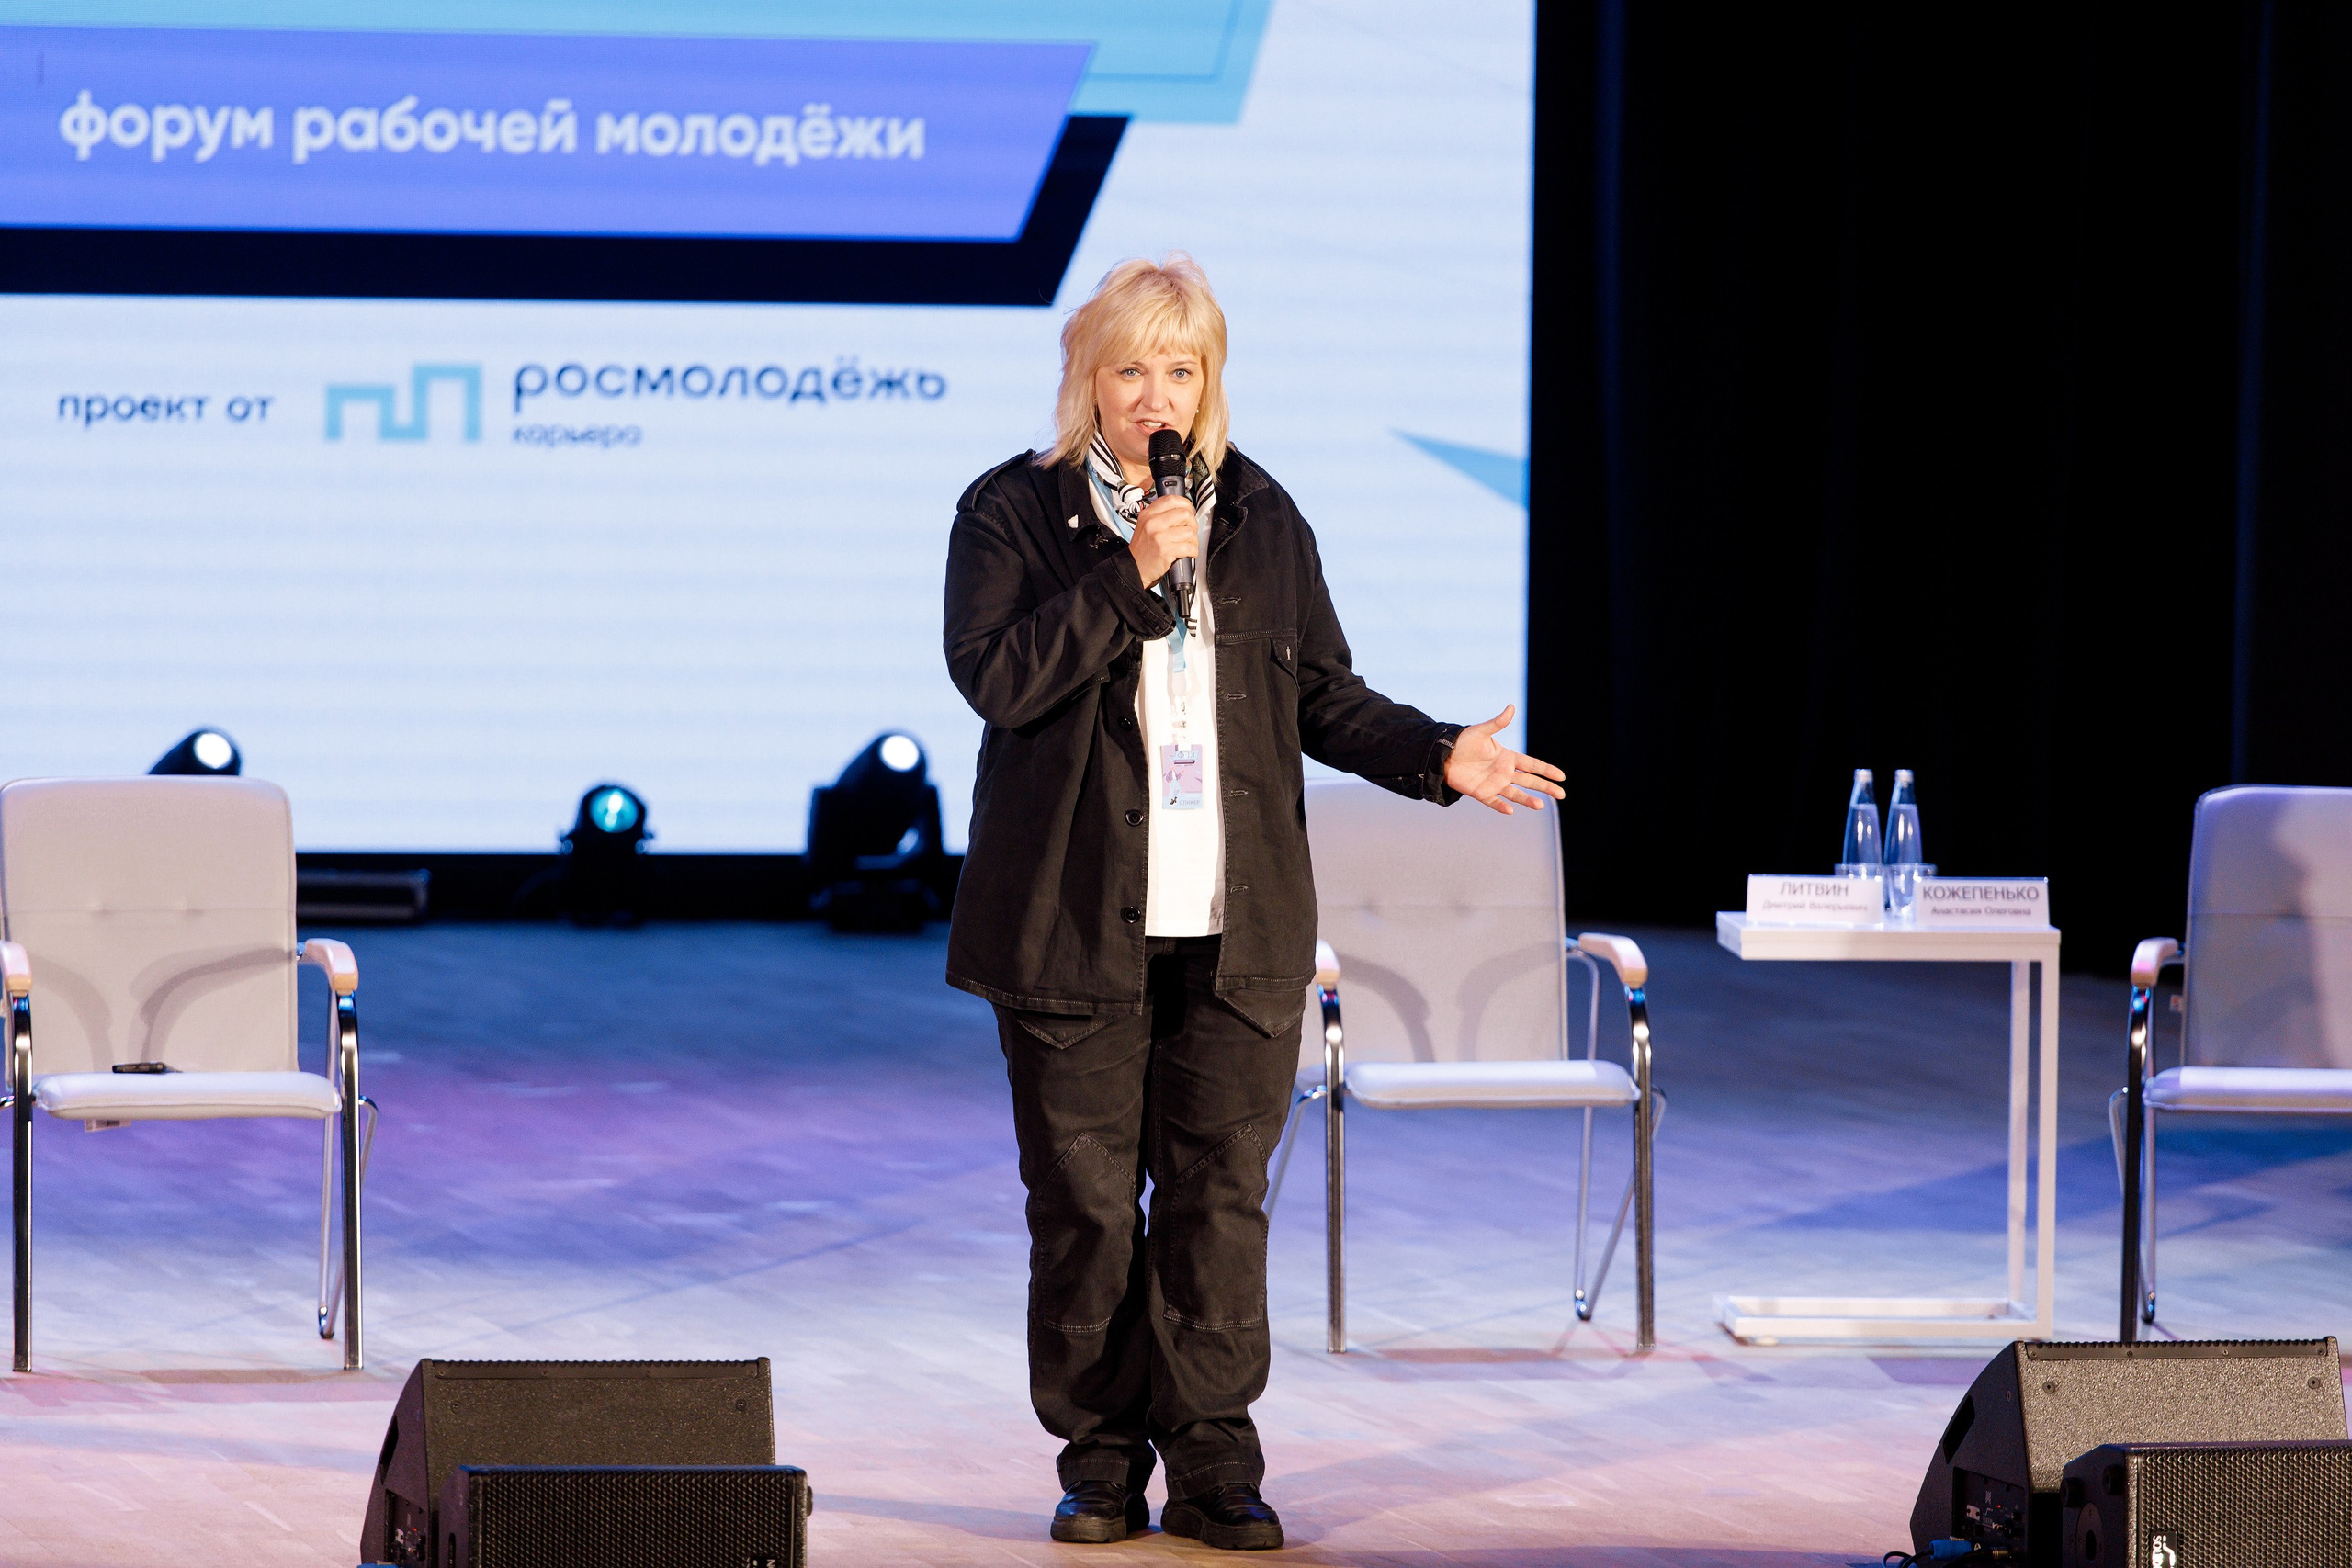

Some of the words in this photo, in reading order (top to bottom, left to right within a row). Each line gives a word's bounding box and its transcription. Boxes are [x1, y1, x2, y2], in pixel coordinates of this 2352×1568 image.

[59, 89, 274, 161] форум
[292, 95, 577, 164] рабочей
[595, 103, 925, 166] молодёжи
[514, 355, 947, 415] росмолодёжь
[58, 394, 210, 429] проект
[226, 395, 275, 423] от
[512, 423, 642, 449] карьера
[1781, 881, 1849, 897] ЛИТВИН
[1922, 886, 2040, 900] КОЖЕПЕНЬКО
